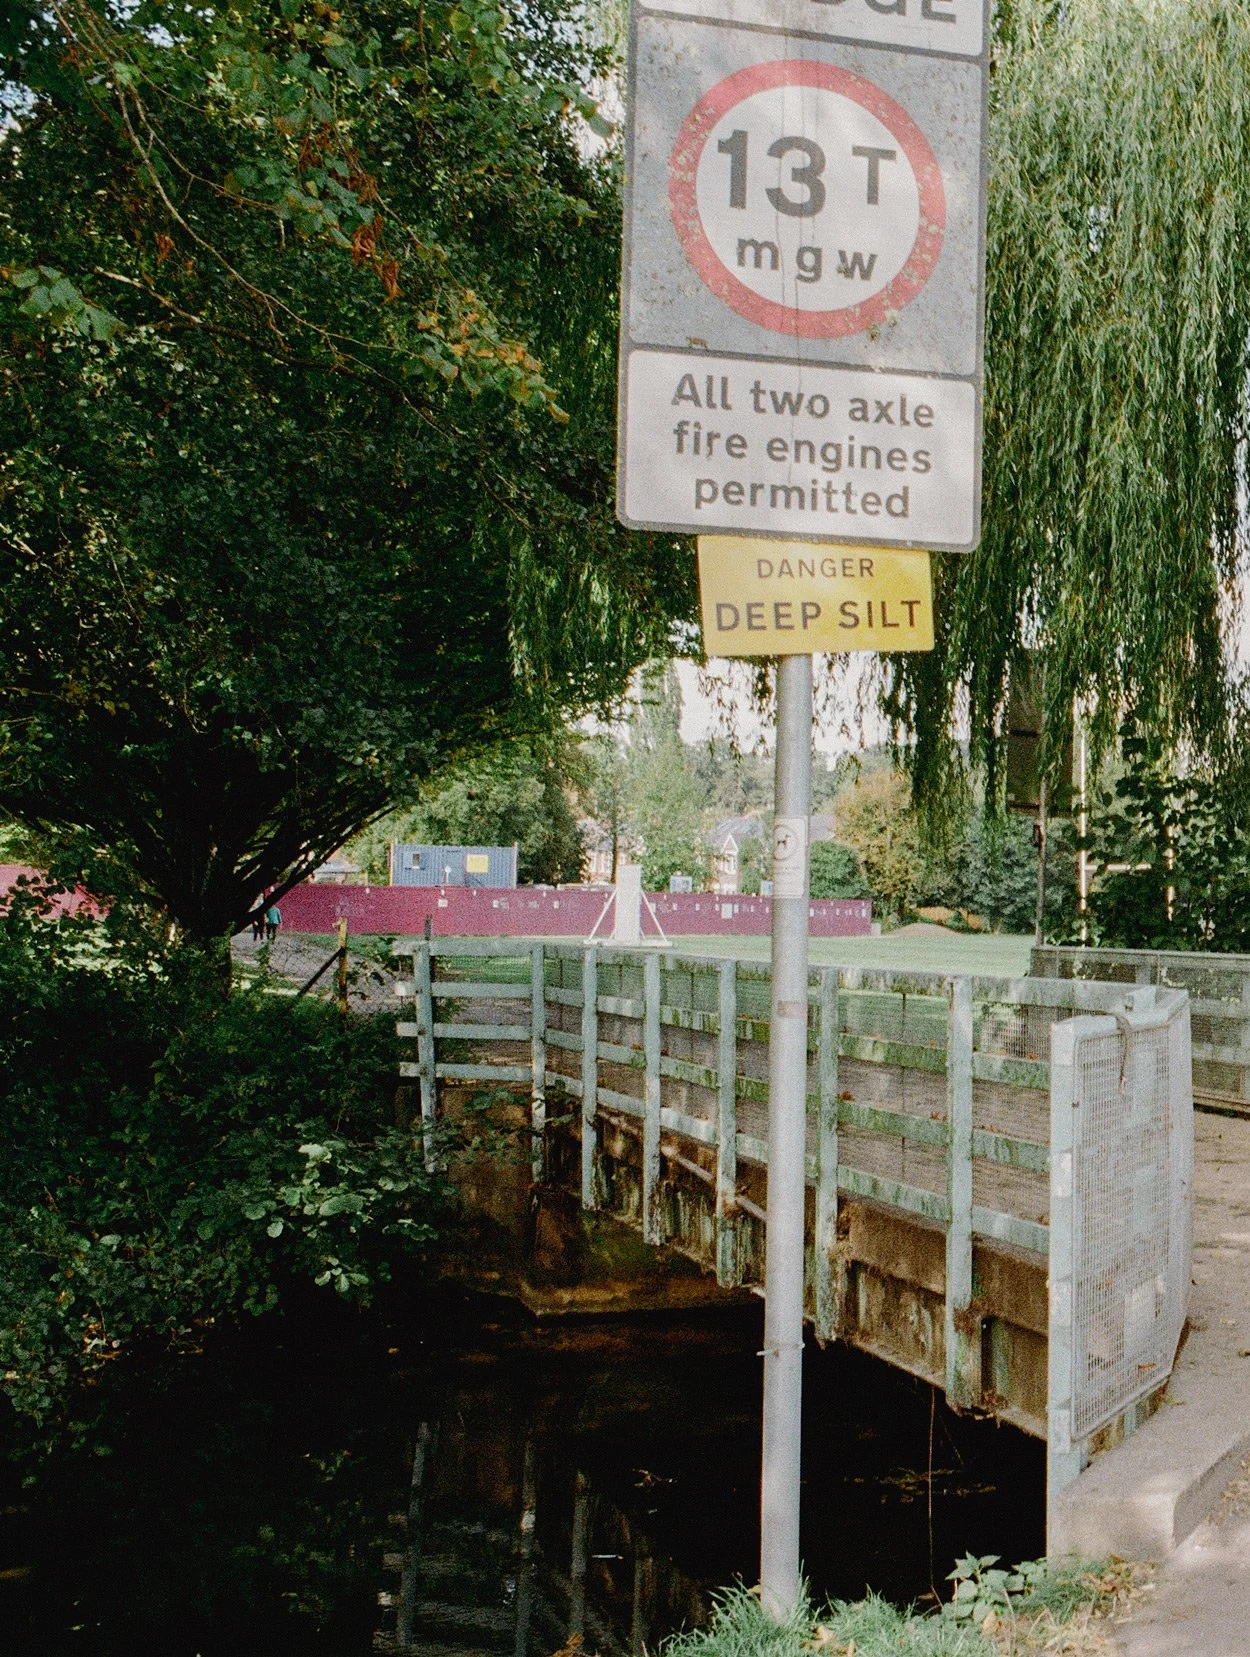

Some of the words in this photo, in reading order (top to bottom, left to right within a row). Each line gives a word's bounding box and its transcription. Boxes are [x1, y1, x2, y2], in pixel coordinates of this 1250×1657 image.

[717, 129, 827, 219] 13
[852, 146, 897, 206] T
[671, 373, 732, 410] All
[749, 380, 830, 418] two
[848, 393, 935, 428] axle
[673, 420, 747, 460] fire
[766, 436, 931, 474] engines
[695, 478, 910, 519] permitted
[757, 558, 875, 579] DANGER
[715, 601, 823, 632] DEEP
[838, 601, 921, 630] SILT
